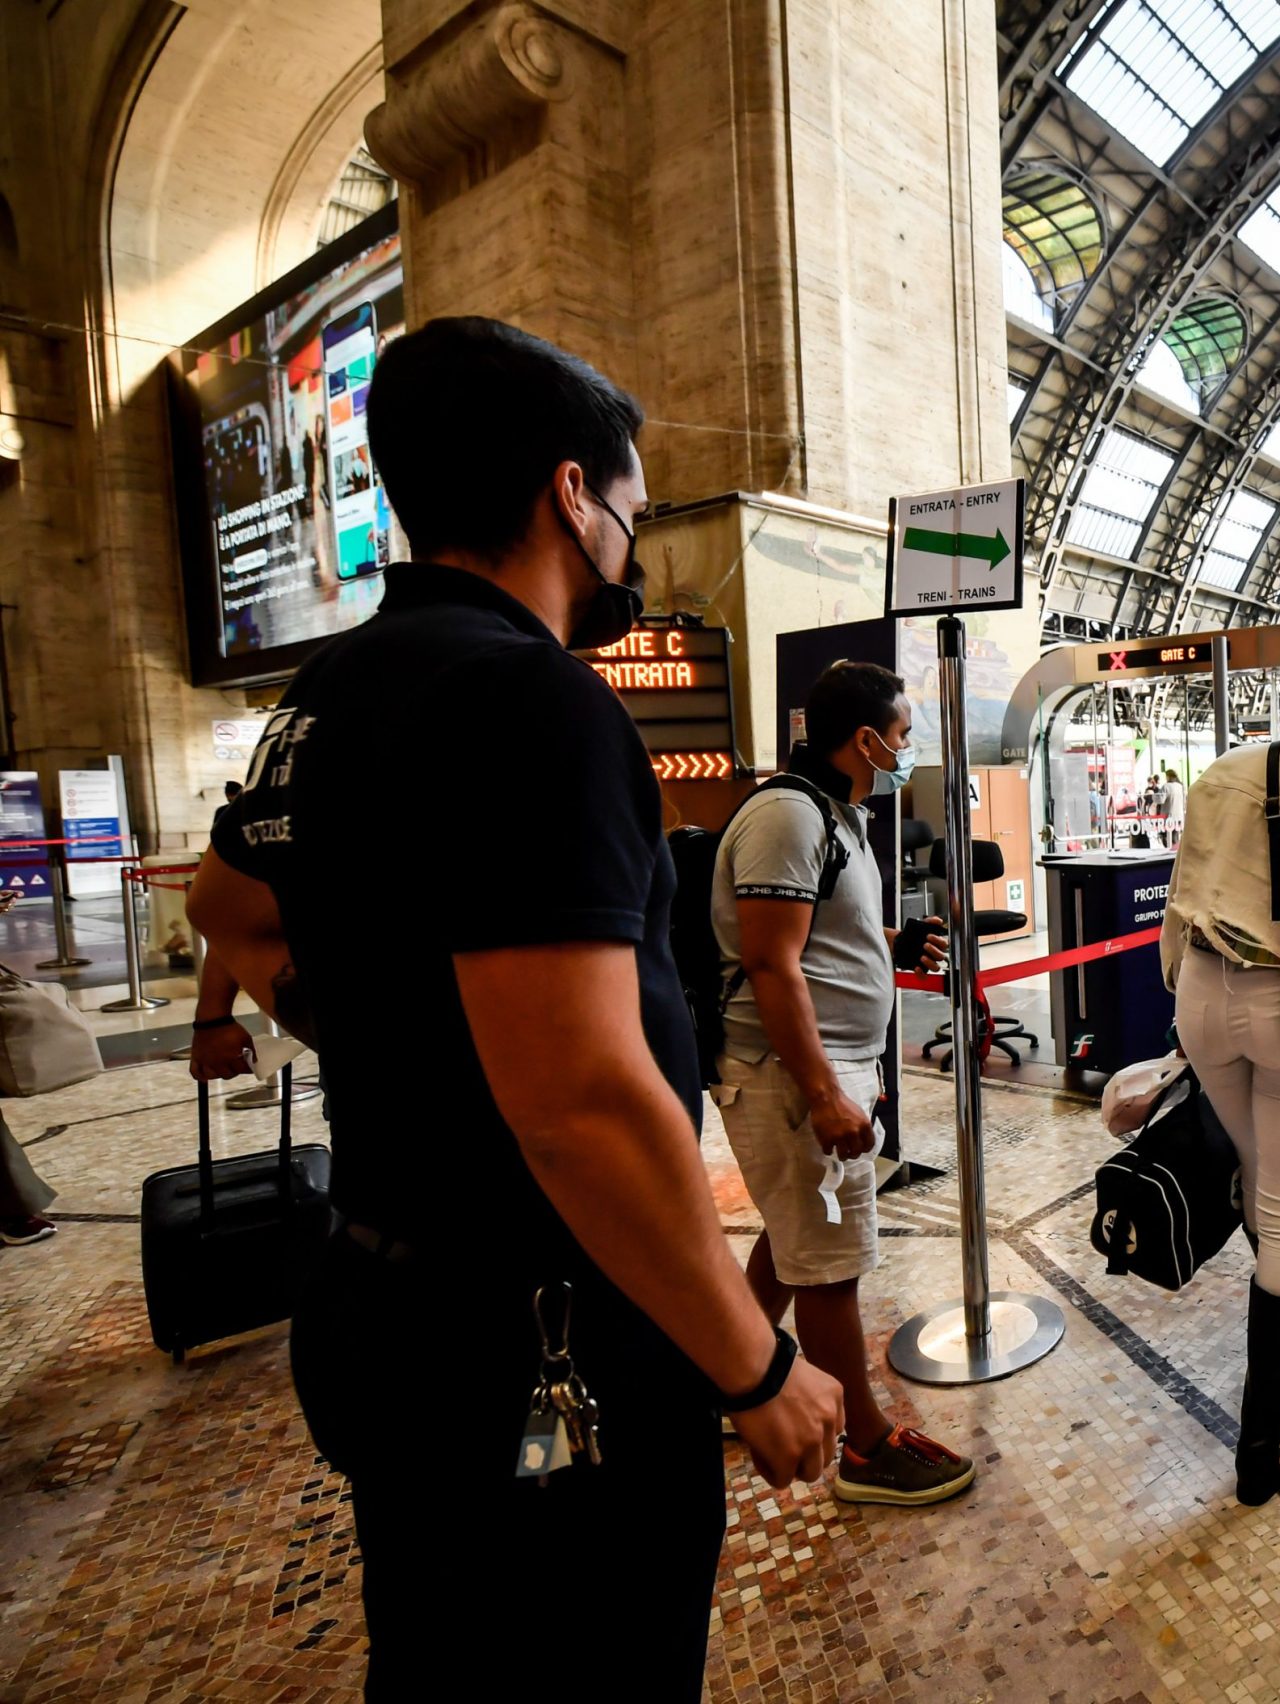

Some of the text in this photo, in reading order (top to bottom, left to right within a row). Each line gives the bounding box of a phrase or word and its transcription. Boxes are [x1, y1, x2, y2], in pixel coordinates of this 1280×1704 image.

[909, 499, 956, 515] ENTRATA
[966, 492, 1001, 508] ENTRY
[917, 591, 947, 603] TRENI
[957, 586, 996, 600] TRAINS
[666, 631, 684, 656] C
[1160, 647, 1196, 662] GATE C
[1002, 747, 1026, 759] GATE
[749, 886, 772, 895] JHB
[774, 888, 797, 897] JHB
[1134, 884, 1169, 903] PROTEZ
[1134, 910, 1159, 923] GRUPPO
